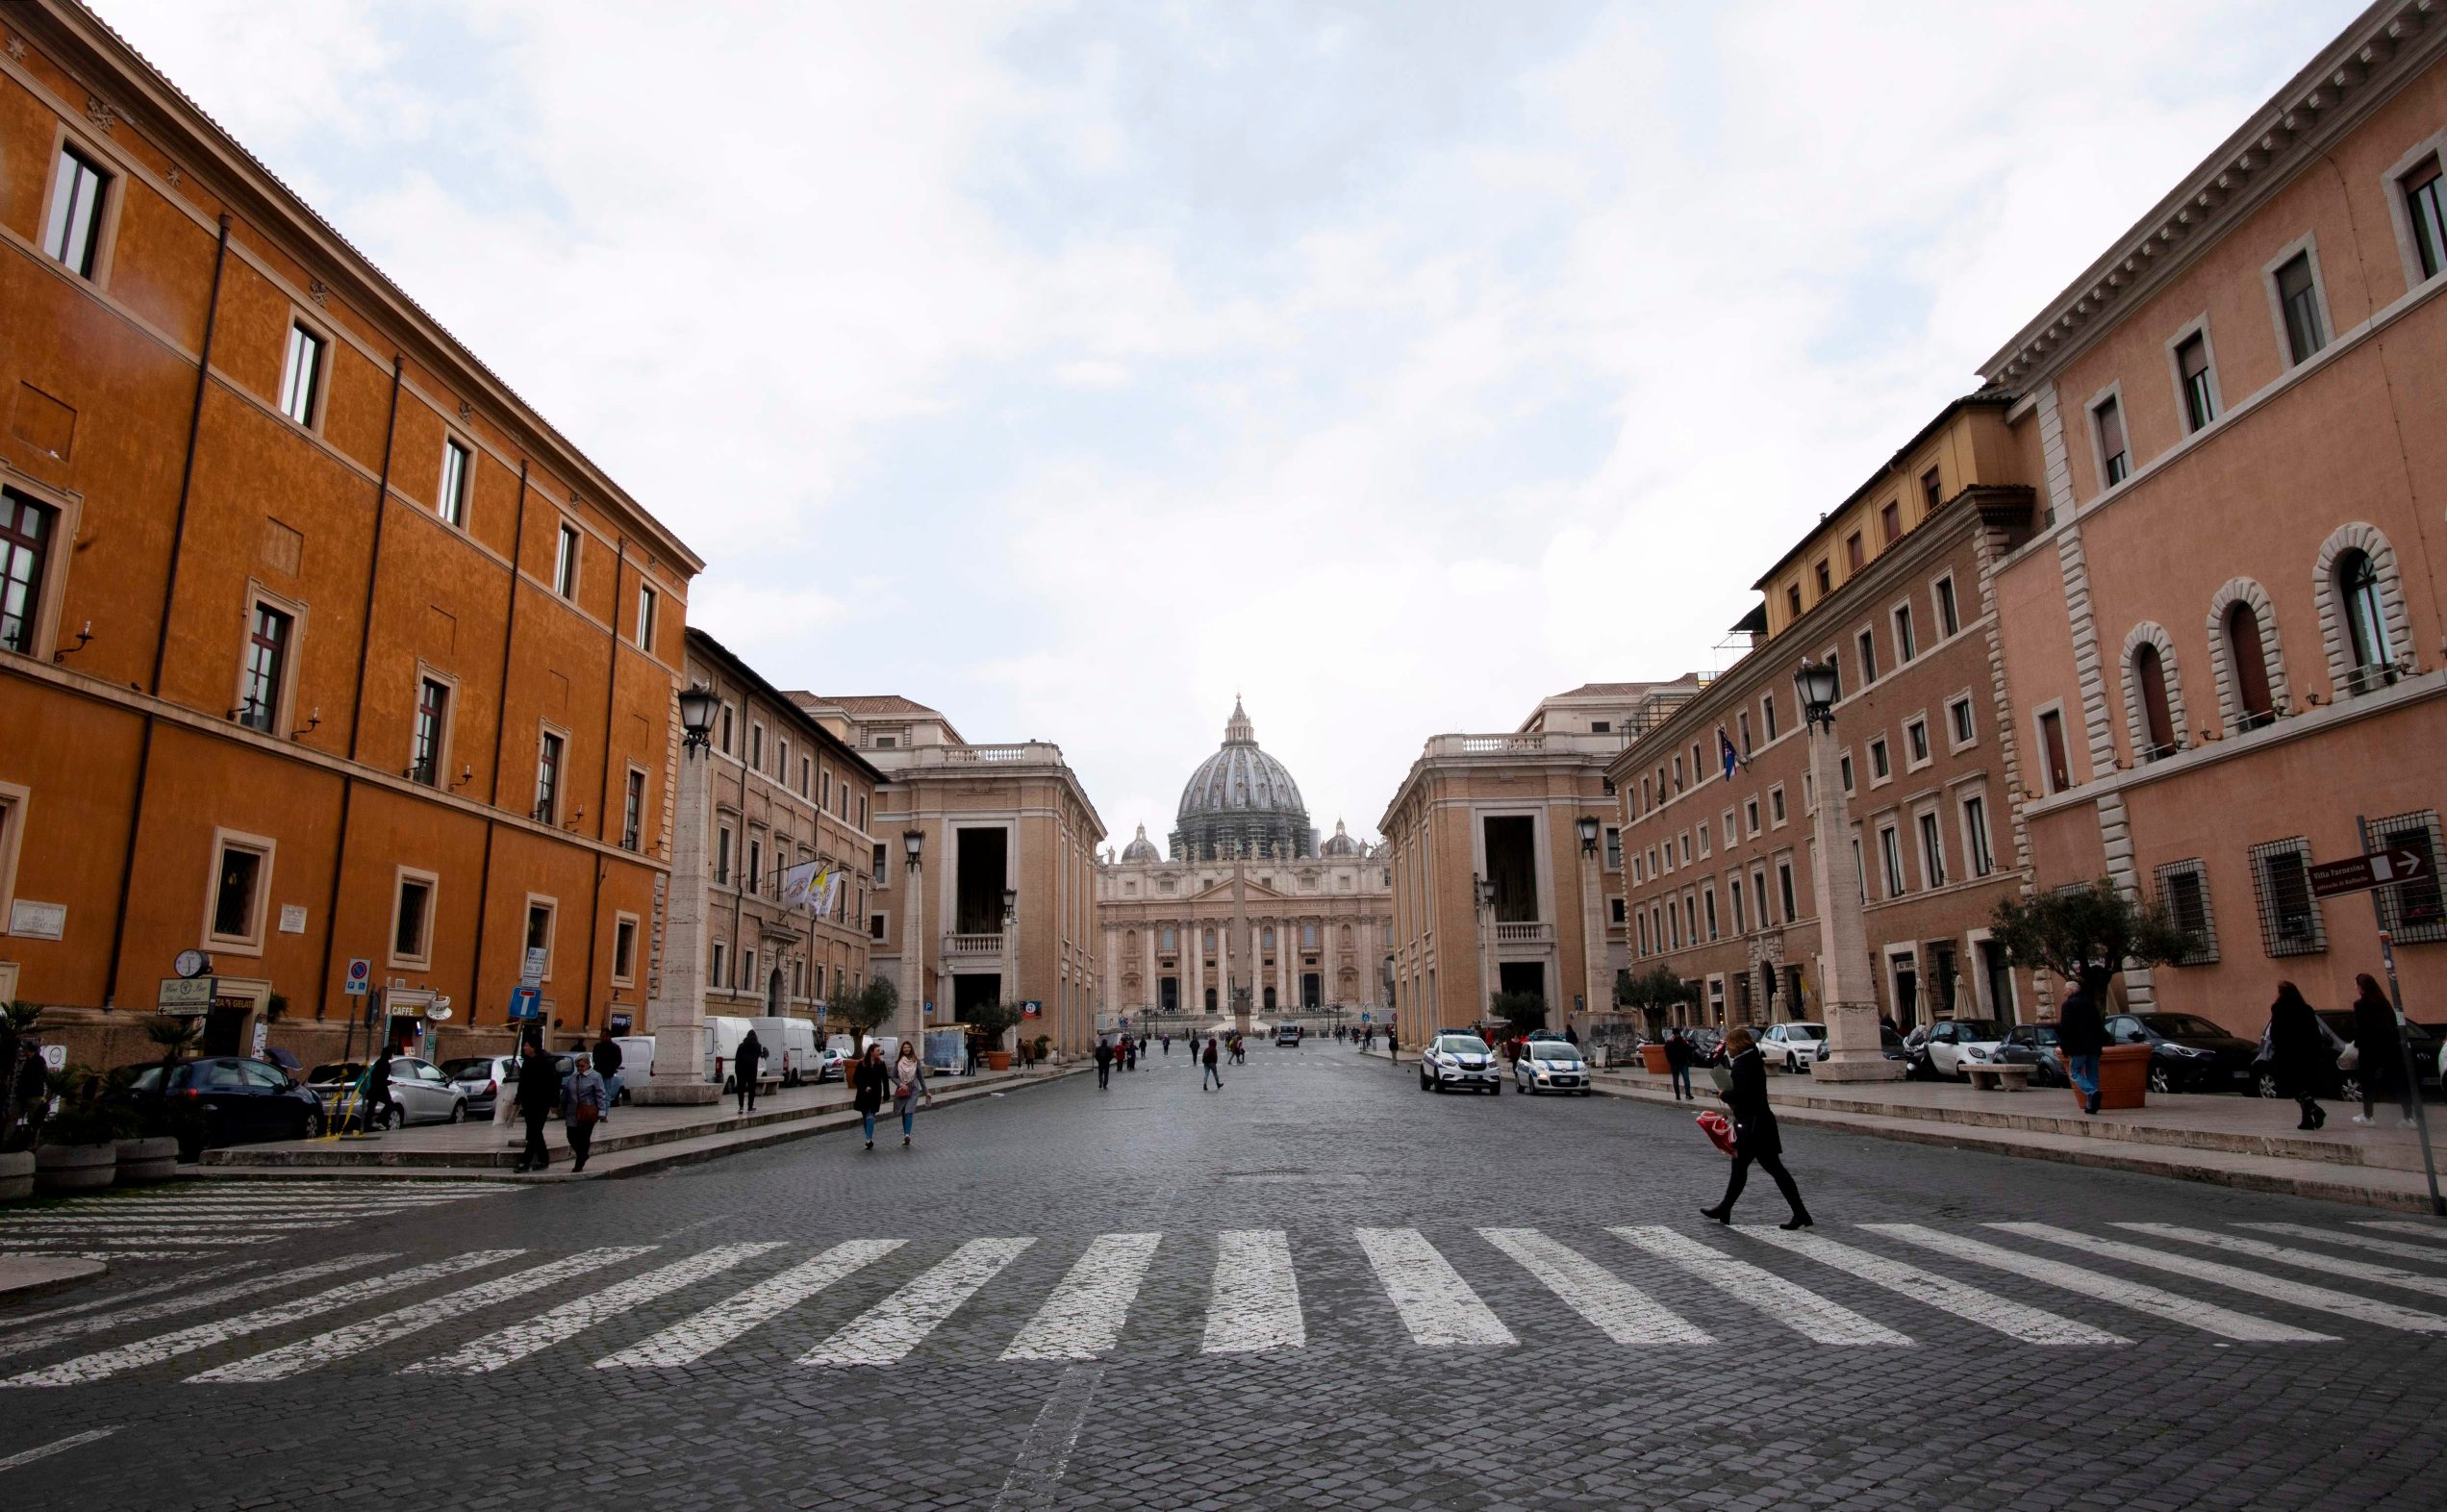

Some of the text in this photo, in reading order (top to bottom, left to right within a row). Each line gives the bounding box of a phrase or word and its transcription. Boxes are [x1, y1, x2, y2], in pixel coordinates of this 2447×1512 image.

[2312, 864, 2365, 880] Villa Farnesina
[612, 1016, 626, 1026] change
